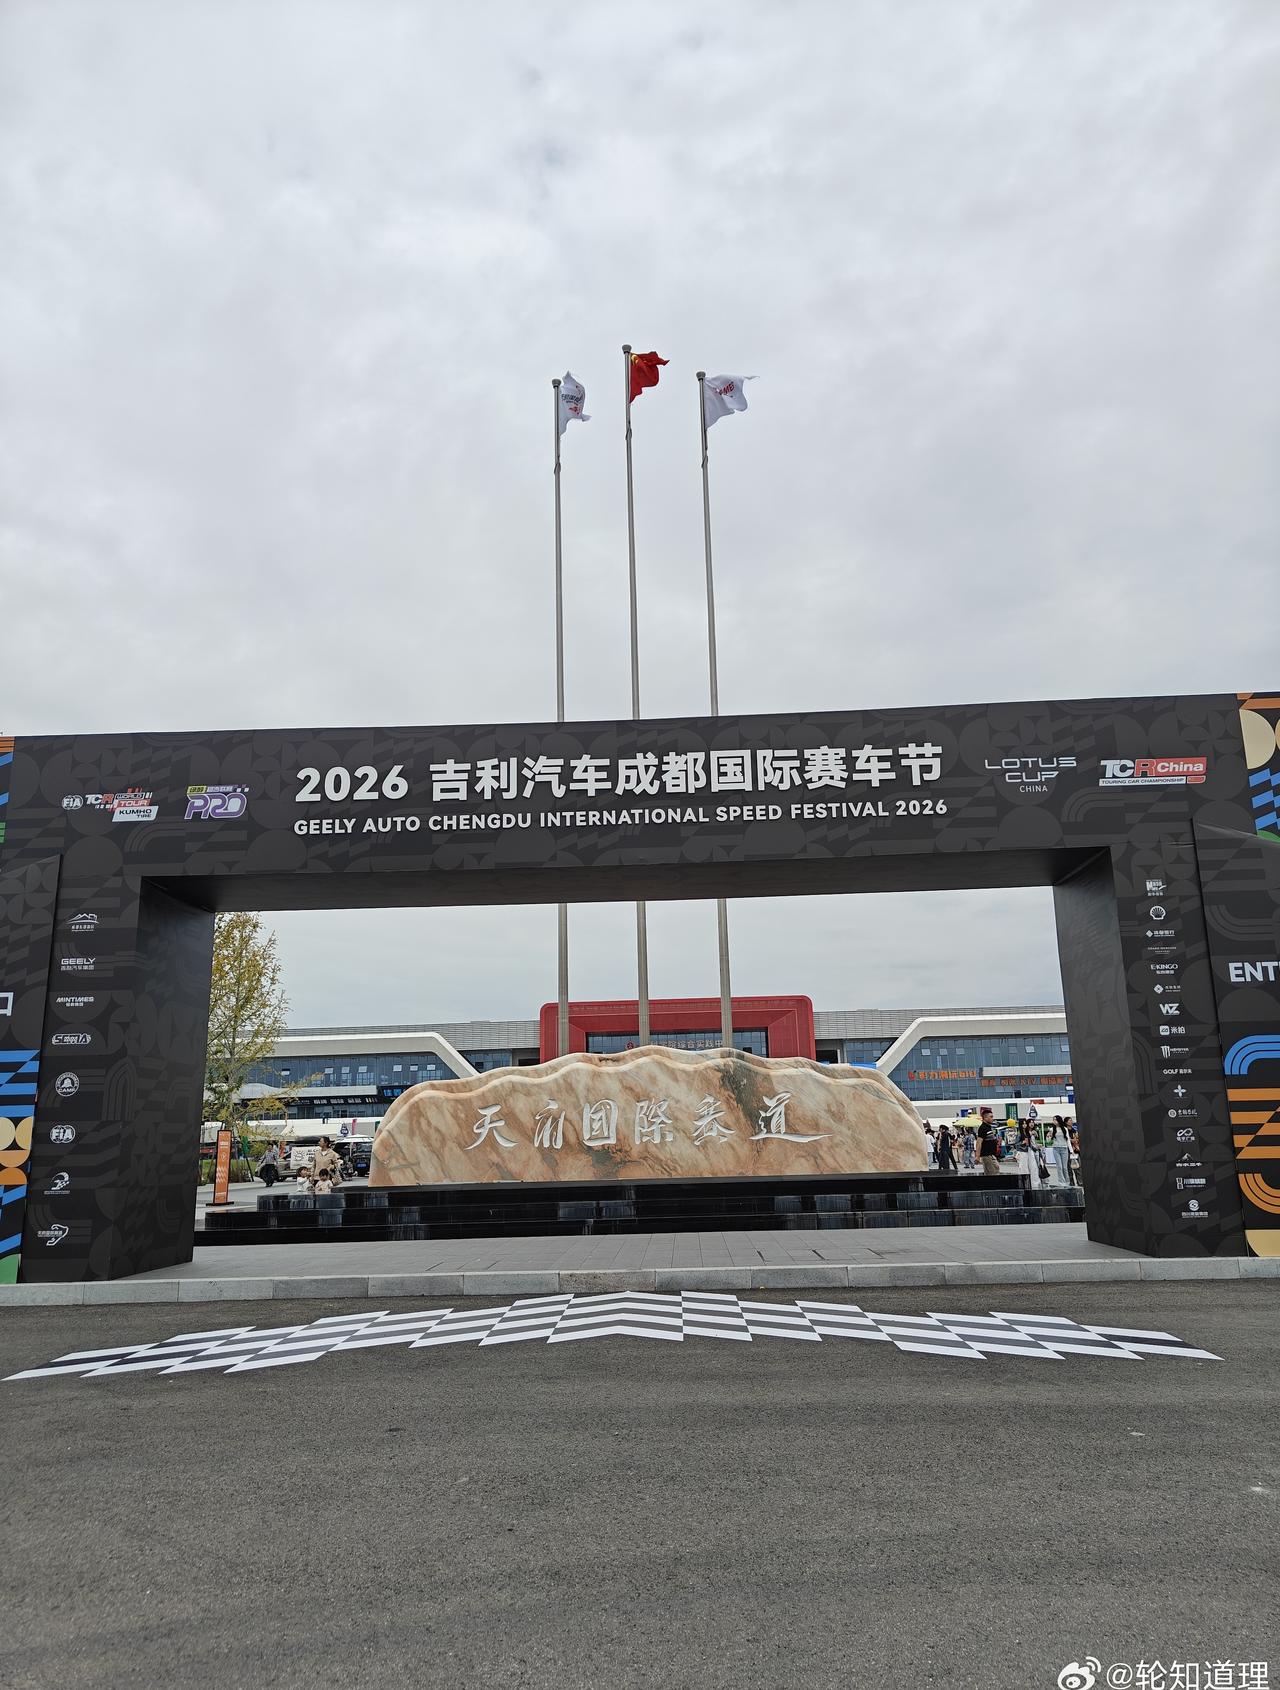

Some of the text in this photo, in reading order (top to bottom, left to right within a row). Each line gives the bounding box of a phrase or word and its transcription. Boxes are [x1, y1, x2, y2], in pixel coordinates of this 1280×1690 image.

[985, 756, 1077, 769] LOTUS
[1157, 762, 1204, 773] China
[295, 743, 943, 803] 2026 吉利汽车成都国际赛车节
[1005, 771, 1059, 782] CUP
[1019, 785, 1048, 793] CHINA
[294, 798, 948, 836] GEELY AUTO CHENGDU INTERNATIONAL SPEED FESTIVAL 2026
[61, 957, 96, 965] GEELY
[1228, 961, 1280, 982] ENT
